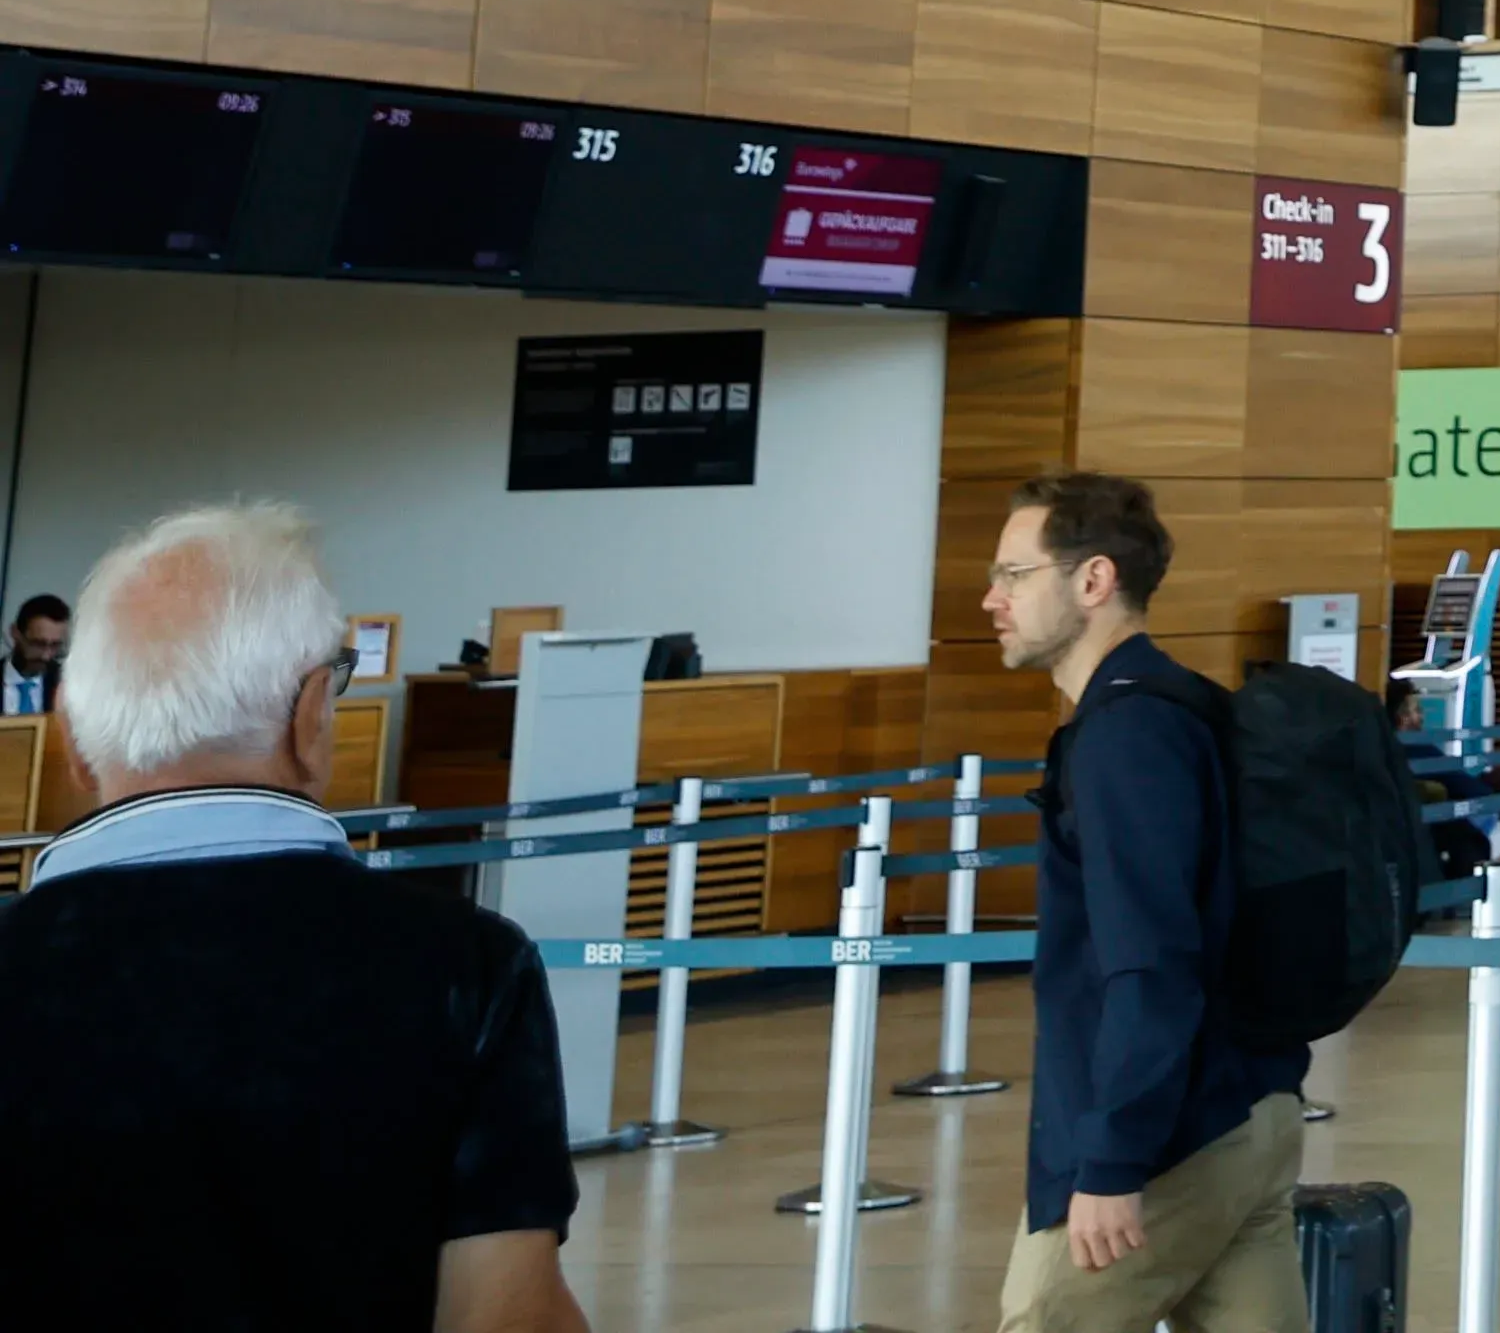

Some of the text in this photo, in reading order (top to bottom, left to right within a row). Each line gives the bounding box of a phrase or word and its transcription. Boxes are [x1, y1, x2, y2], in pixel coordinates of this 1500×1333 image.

[572, 127, 620, 162] 315
[733, 142, 778, 177] 316
[1262, 192, 1390, 303] Check-in 3
[584, 944, 623, 964] BER
[832, 941, 871, 962] BER
